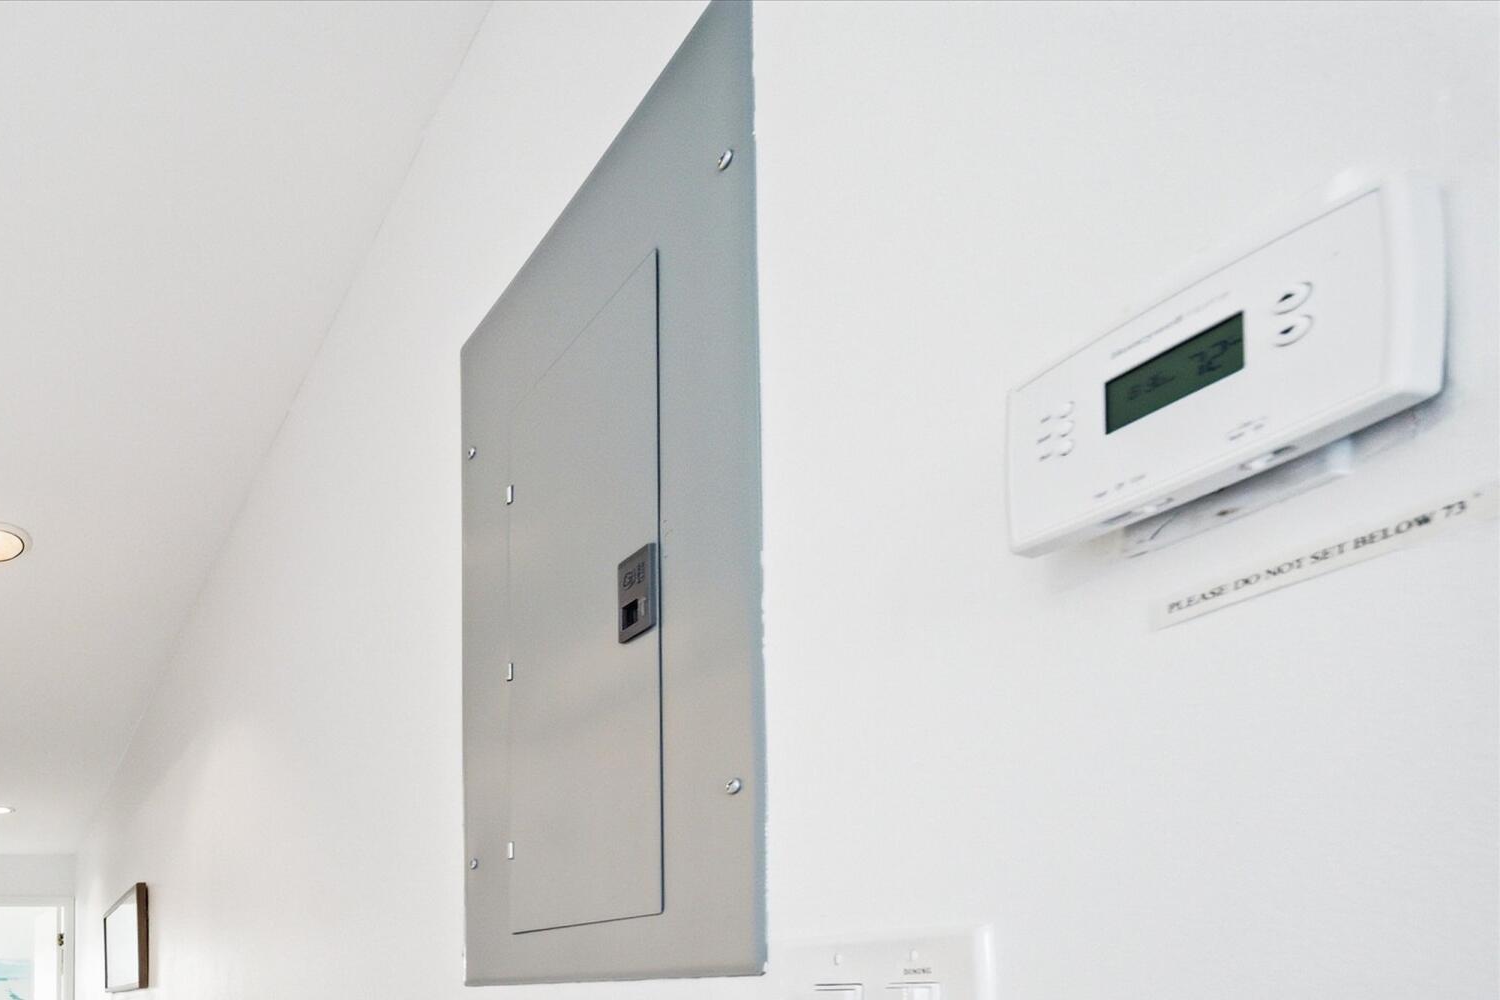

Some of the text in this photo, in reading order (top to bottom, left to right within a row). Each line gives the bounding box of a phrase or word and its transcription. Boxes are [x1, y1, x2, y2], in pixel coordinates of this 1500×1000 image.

[1168, 584, 1228, 614] PLEASE
[1234, 574, 1261, 591] DO
[1265, 557, 1305, 579] NOT
[1309, 541, 1348, 565] SET
[1353, 511, 1436, 550] BELOW
